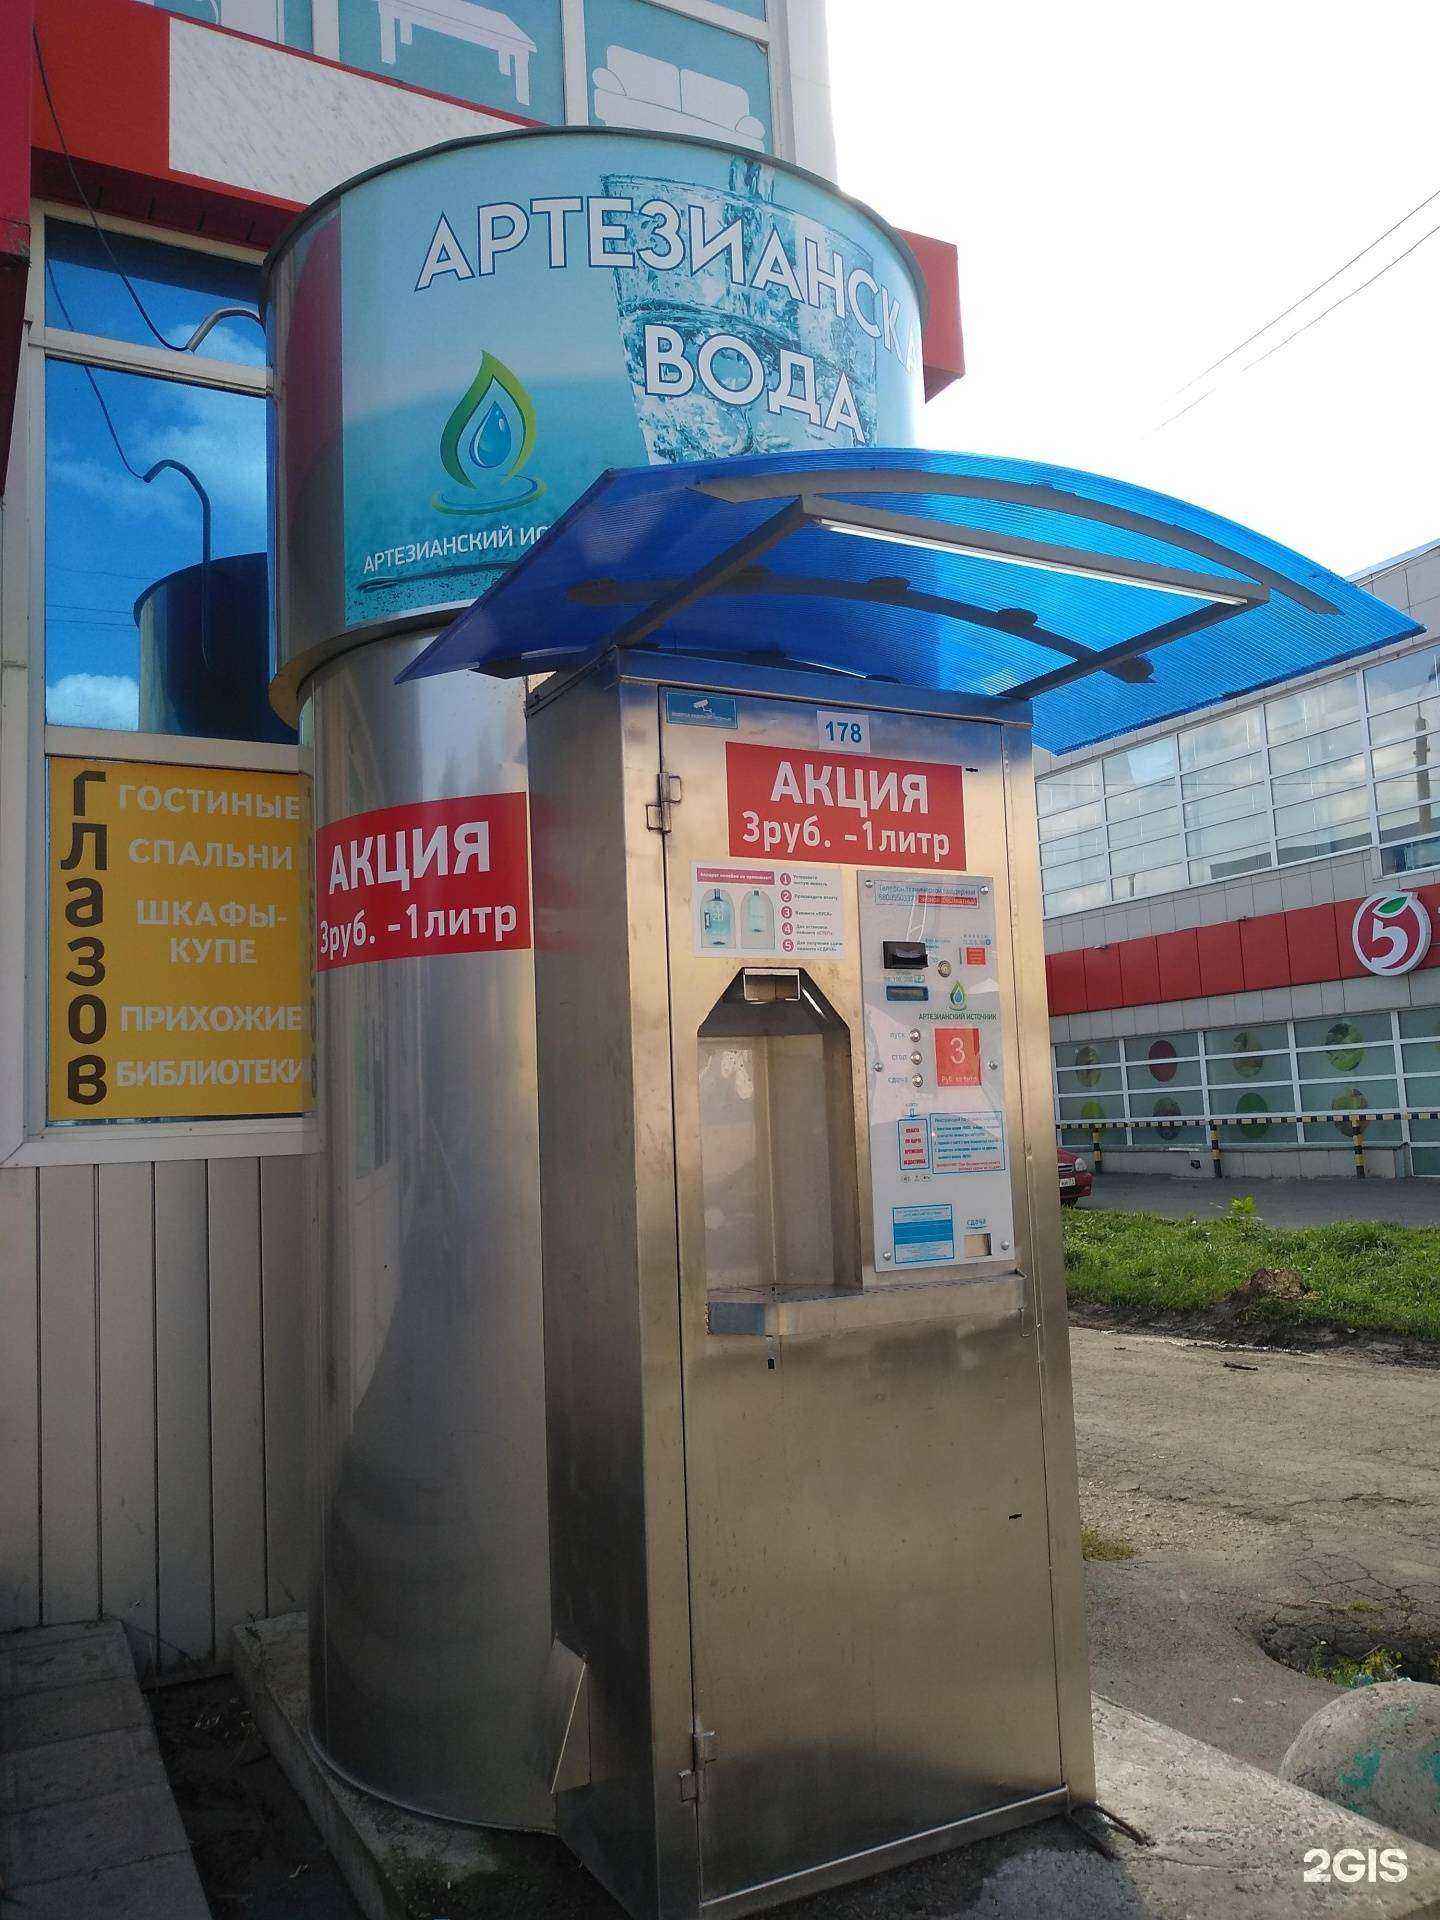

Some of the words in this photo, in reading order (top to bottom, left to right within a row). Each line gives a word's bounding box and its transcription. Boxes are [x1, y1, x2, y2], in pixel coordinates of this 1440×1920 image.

[643, 323, 866, 444] ВОДА
[363, 521, 513, 574] АРТЕЗИАНСКИЙ
[520, 525, 551, 546] ИС
[825, 720, 862, 744] 178
[117, 783, 302, 821] ГОСТИНЫЕ
[770, 760, 929, 818] АКЦИЯ
[742, 809, 832, 854] 3руб.
[128, 837, 293, 870] СПАЛЬНИ
[328, 820, 491, 895] АКЦИЯ
[136, 899, 288, 929] ШКАФЫ-
[169, 936, 258, 965] КУПЕ
[320, 909, 376, 961] 3руб.
[119, 1005, 305, 1033] ПРИХОЖИЕ
[950, 1037, 965, 1064] 3
[116, 1059, 308, 1088] БИБЛИОТЕКИ
